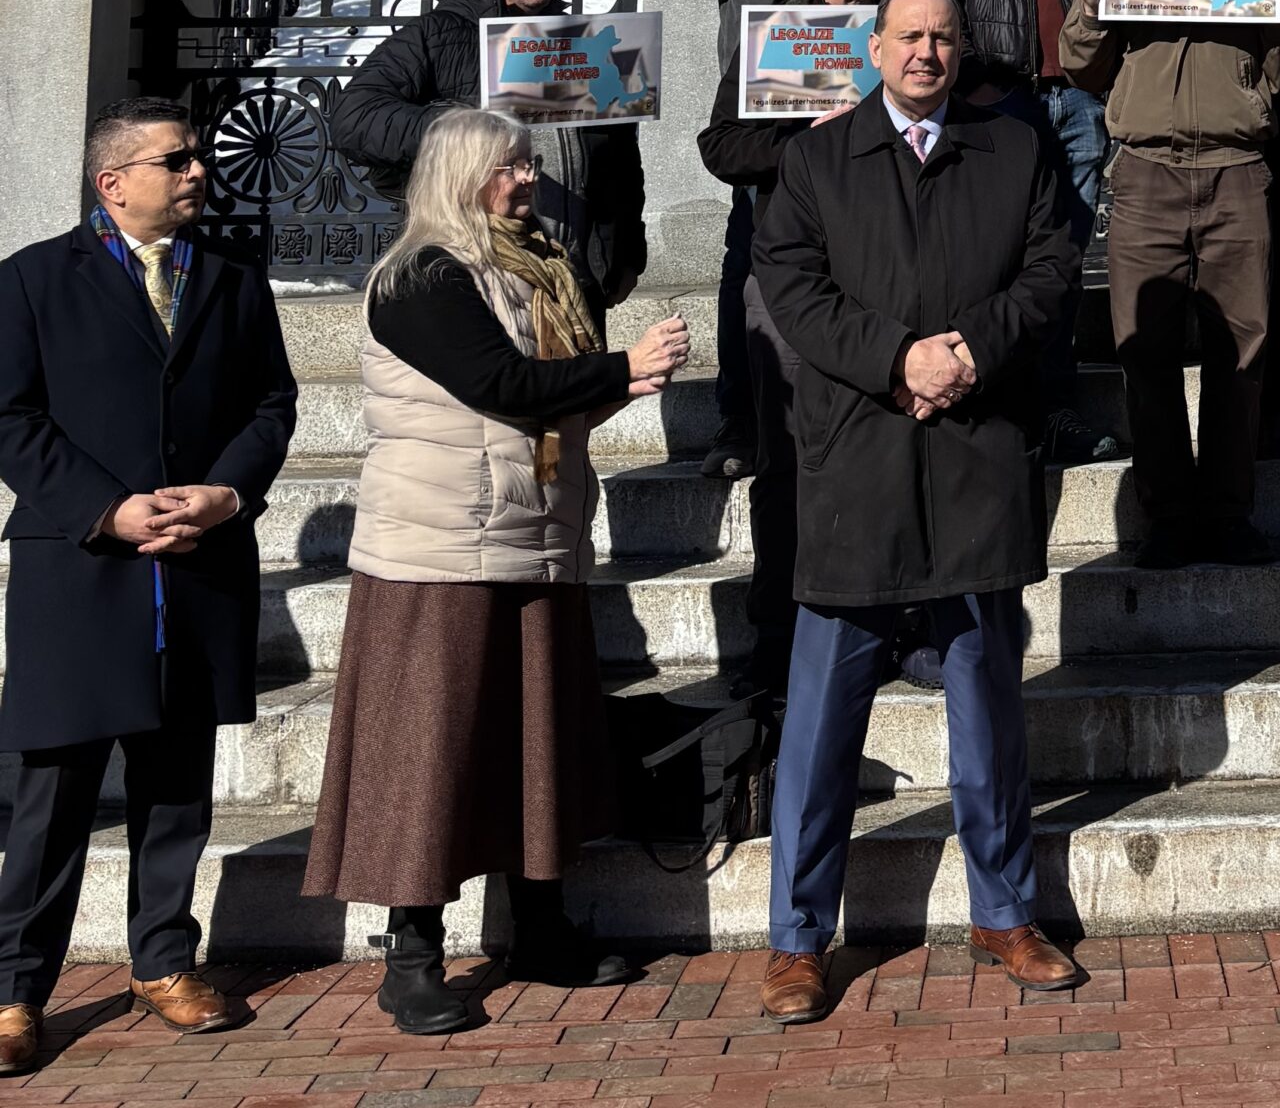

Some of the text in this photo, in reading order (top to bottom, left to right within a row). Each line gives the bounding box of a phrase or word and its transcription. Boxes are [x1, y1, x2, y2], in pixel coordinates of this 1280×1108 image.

[1111, 2, 1199, 12] legalizestarterhomes.com
[770, 28, 834, 41] LEGALIZE
[511, 39, 572, 53] LEGALIZE
[792, 43, 851, 55] STARTER
[533, 52, 588, 67] STARTER
[815, 57, 864, 70] HOMES
[554, 67, 600, 81] HOMES
[752, 98, 848, 108] legalizestarterhomes.com
